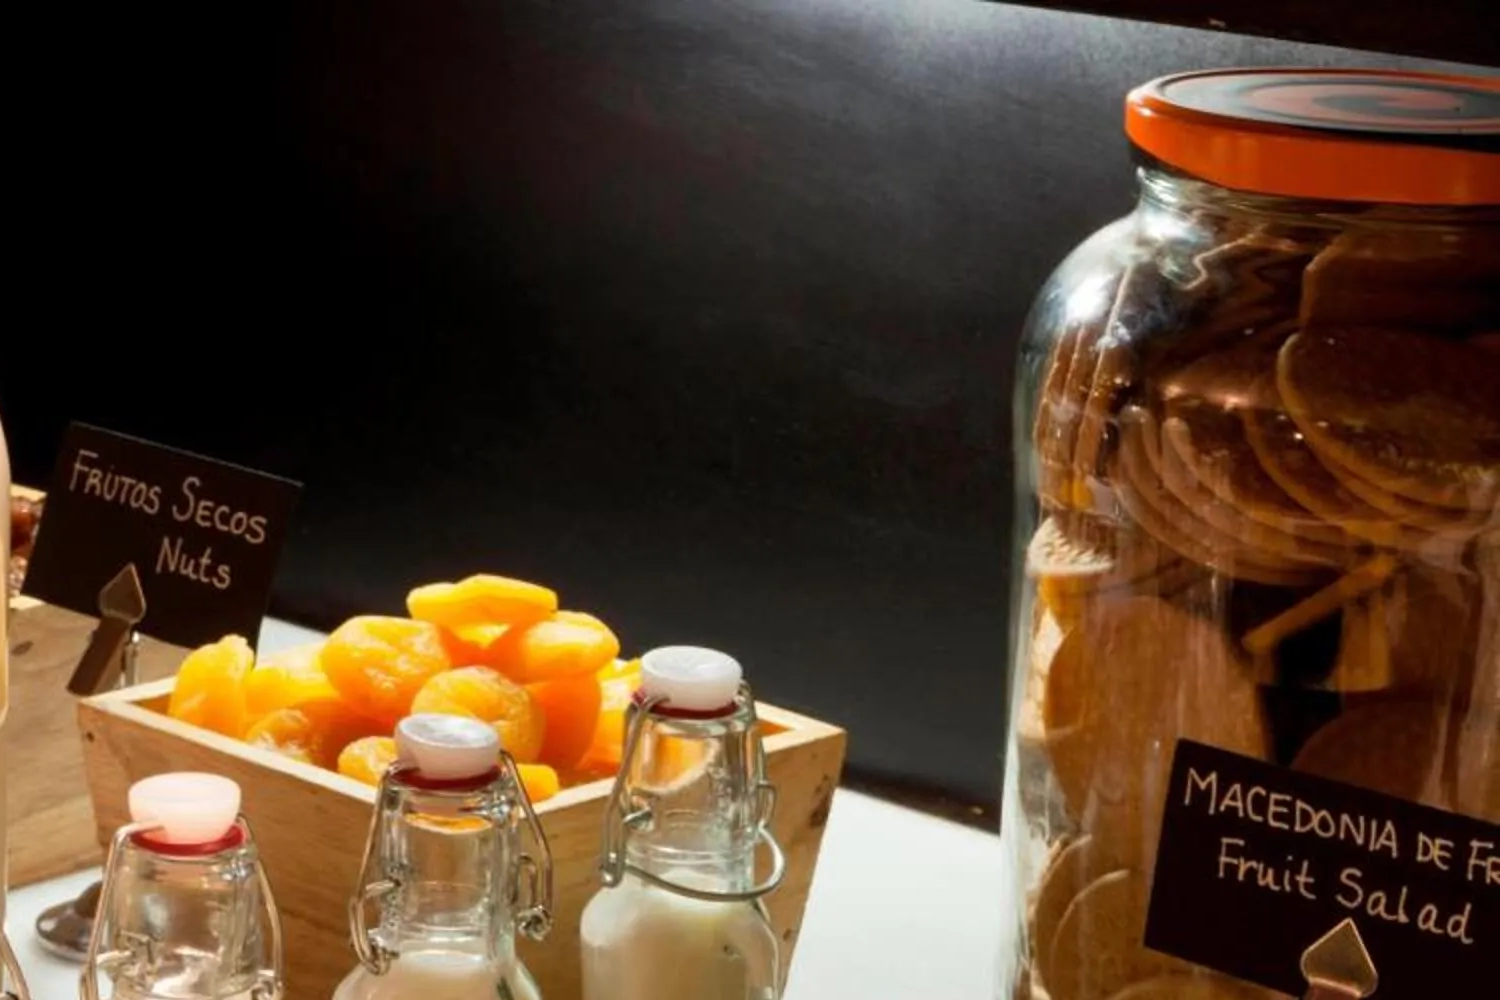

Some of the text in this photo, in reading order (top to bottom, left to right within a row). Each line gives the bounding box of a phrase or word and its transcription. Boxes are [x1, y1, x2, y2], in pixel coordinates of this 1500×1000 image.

[69, 449, 267, 544] FRUTOS SECOS
[156, 536, 231, 589] Nuts
[1184, 767, 1398, 858] MACEDONIA
[1415, 831, 1455, 871] DE
[1218, 837, 1474, 944] Fruit Salad
